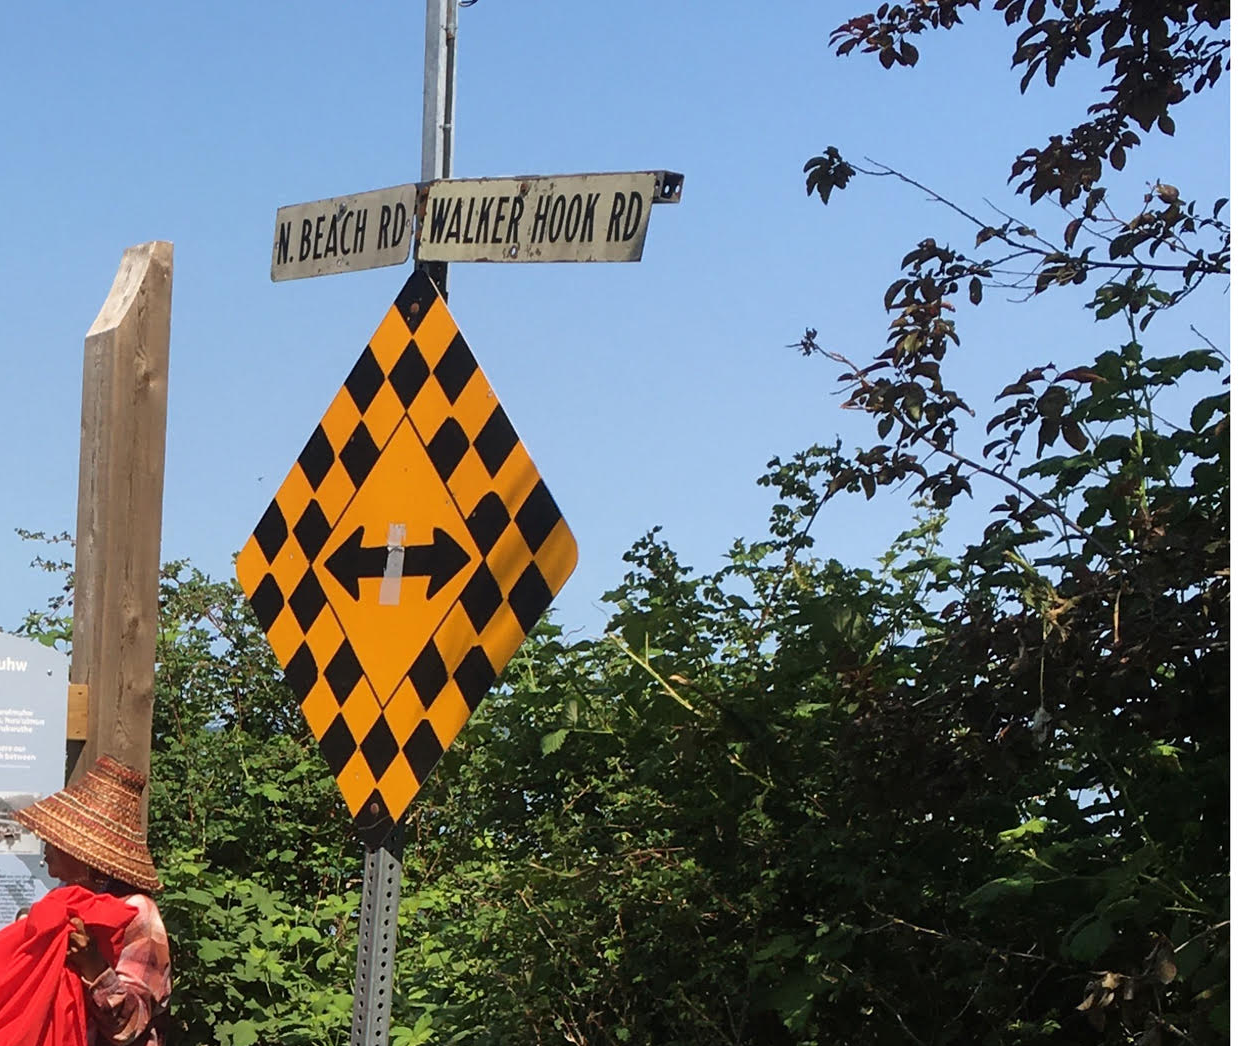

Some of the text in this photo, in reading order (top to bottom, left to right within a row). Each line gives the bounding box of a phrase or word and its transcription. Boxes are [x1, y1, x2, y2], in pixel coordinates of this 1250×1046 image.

[277, 202, 406, 265] N. BEACH RD
[429, 191, 643, 244] WALKER HOOK RD
